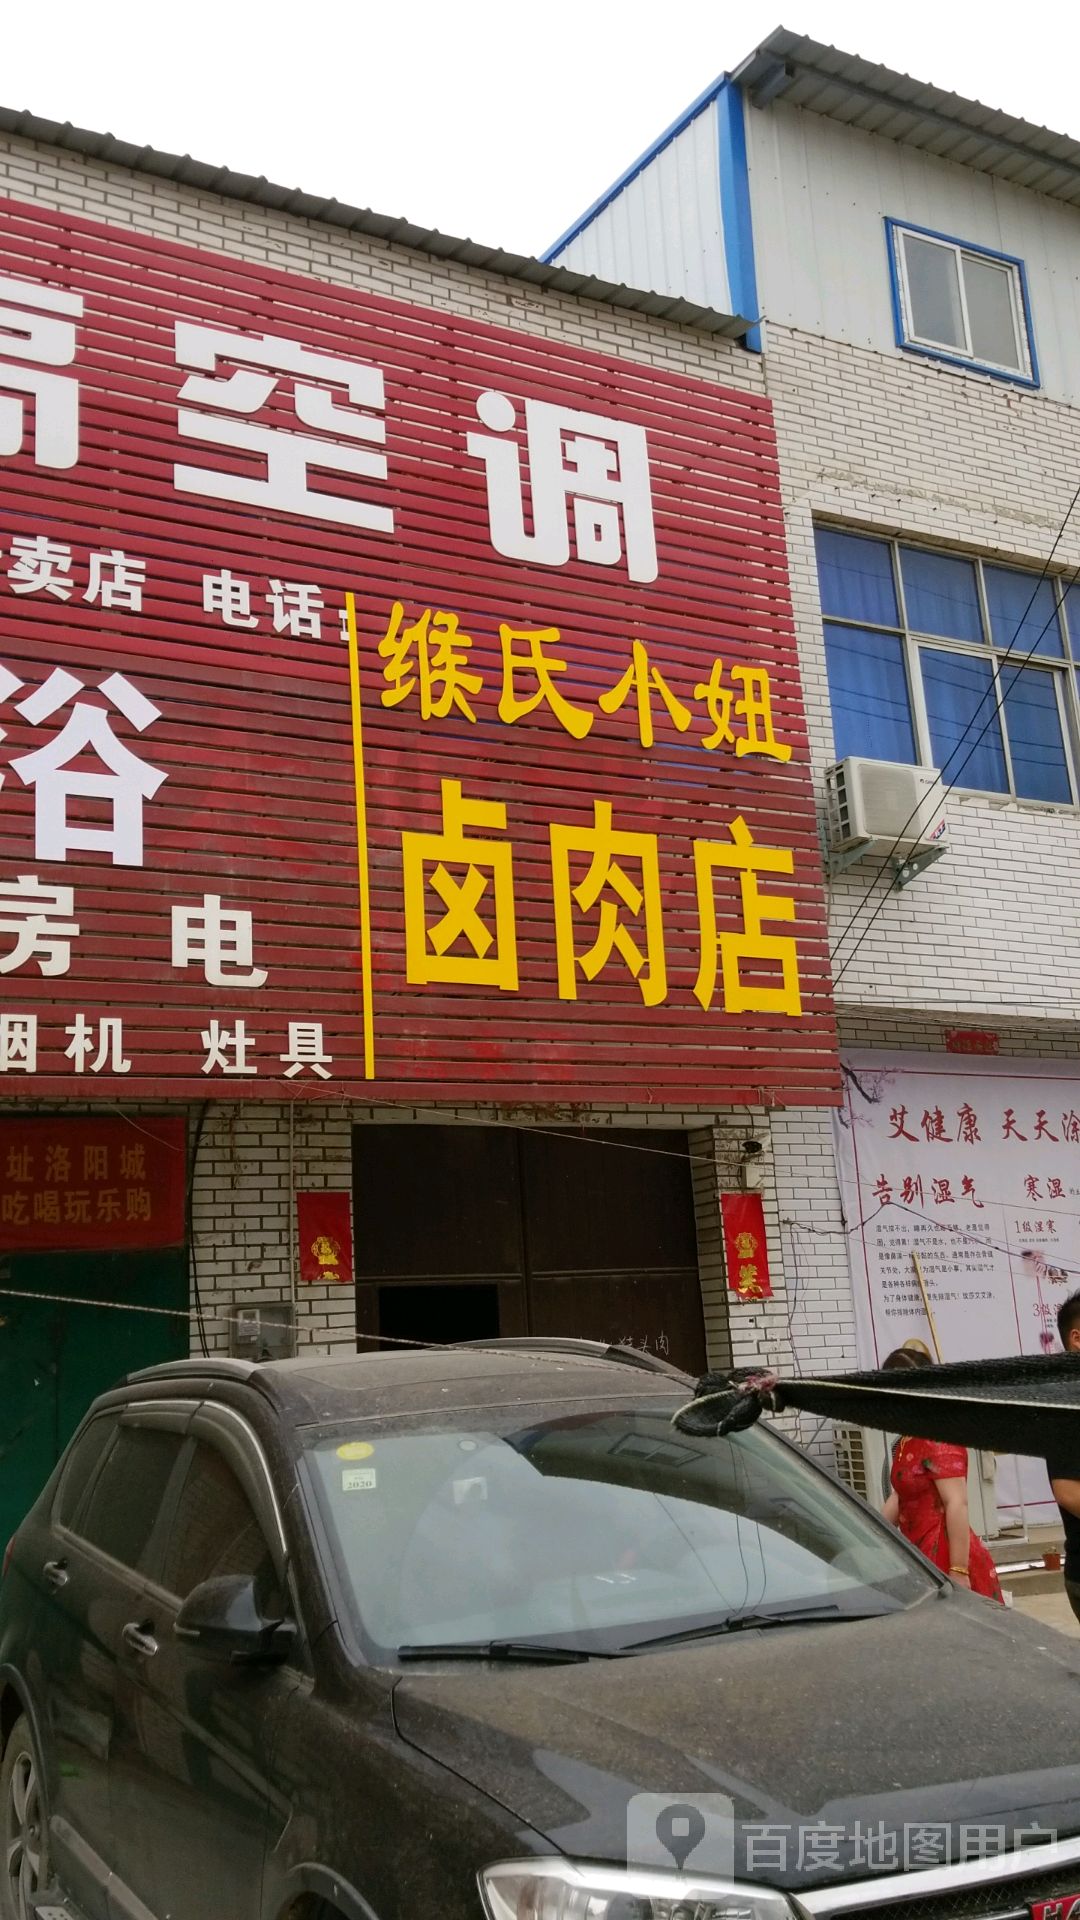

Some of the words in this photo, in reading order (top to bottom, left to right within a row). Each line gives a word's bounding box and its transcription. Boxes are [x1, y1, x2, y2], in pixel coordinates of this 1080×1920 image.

[401, 778, 802, 1017] 卤肉店
[201, 1020, 333, 1080] 灶具
[887, 1102, 982, 1145] 艾健康
[5, 1143, 147, 1182] 址洛阳城
[1, 1188, 152, 1225] 吃喝玩乐购
[872, 1173, 984, 1209] 告别湿气
